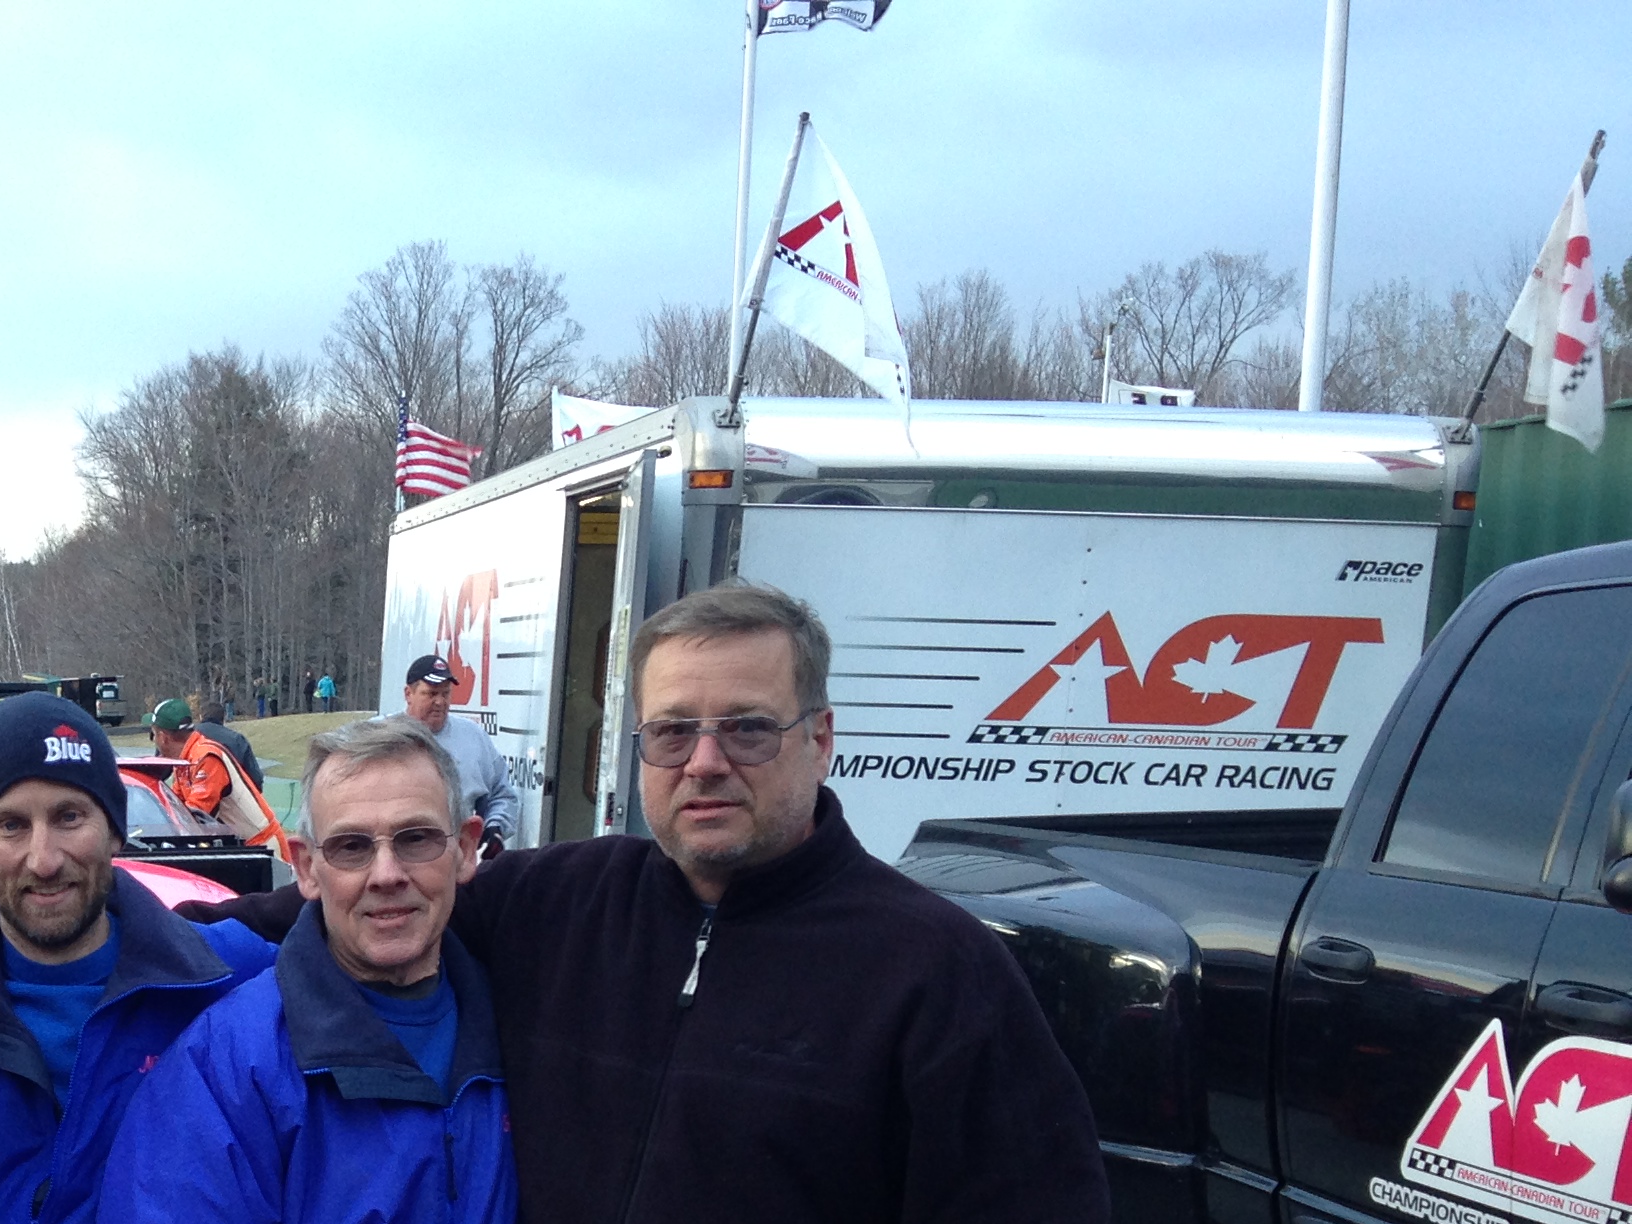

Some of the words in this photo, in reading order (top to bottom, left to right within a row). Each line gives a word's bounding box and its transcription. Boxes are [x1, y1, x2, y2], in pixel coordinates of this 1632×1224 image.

[1353, 561, 1424, 582] pace
[1363, 576, 1413, 584] AMERICAN
[984, 610, 1385, 730] ACT
[44, 736, 92, 763] Blue
[1216, 736, 1258, 748] TOUR
[828, 754, 1016, 782] MPIONSHIP
[1025, 759, 1136, 785] STOCK
[1144, 762, 1208, 788] CAR
[1215, 764, 1337, 791] RACING
[1568, 1200, 1601, 1219] TOUR
